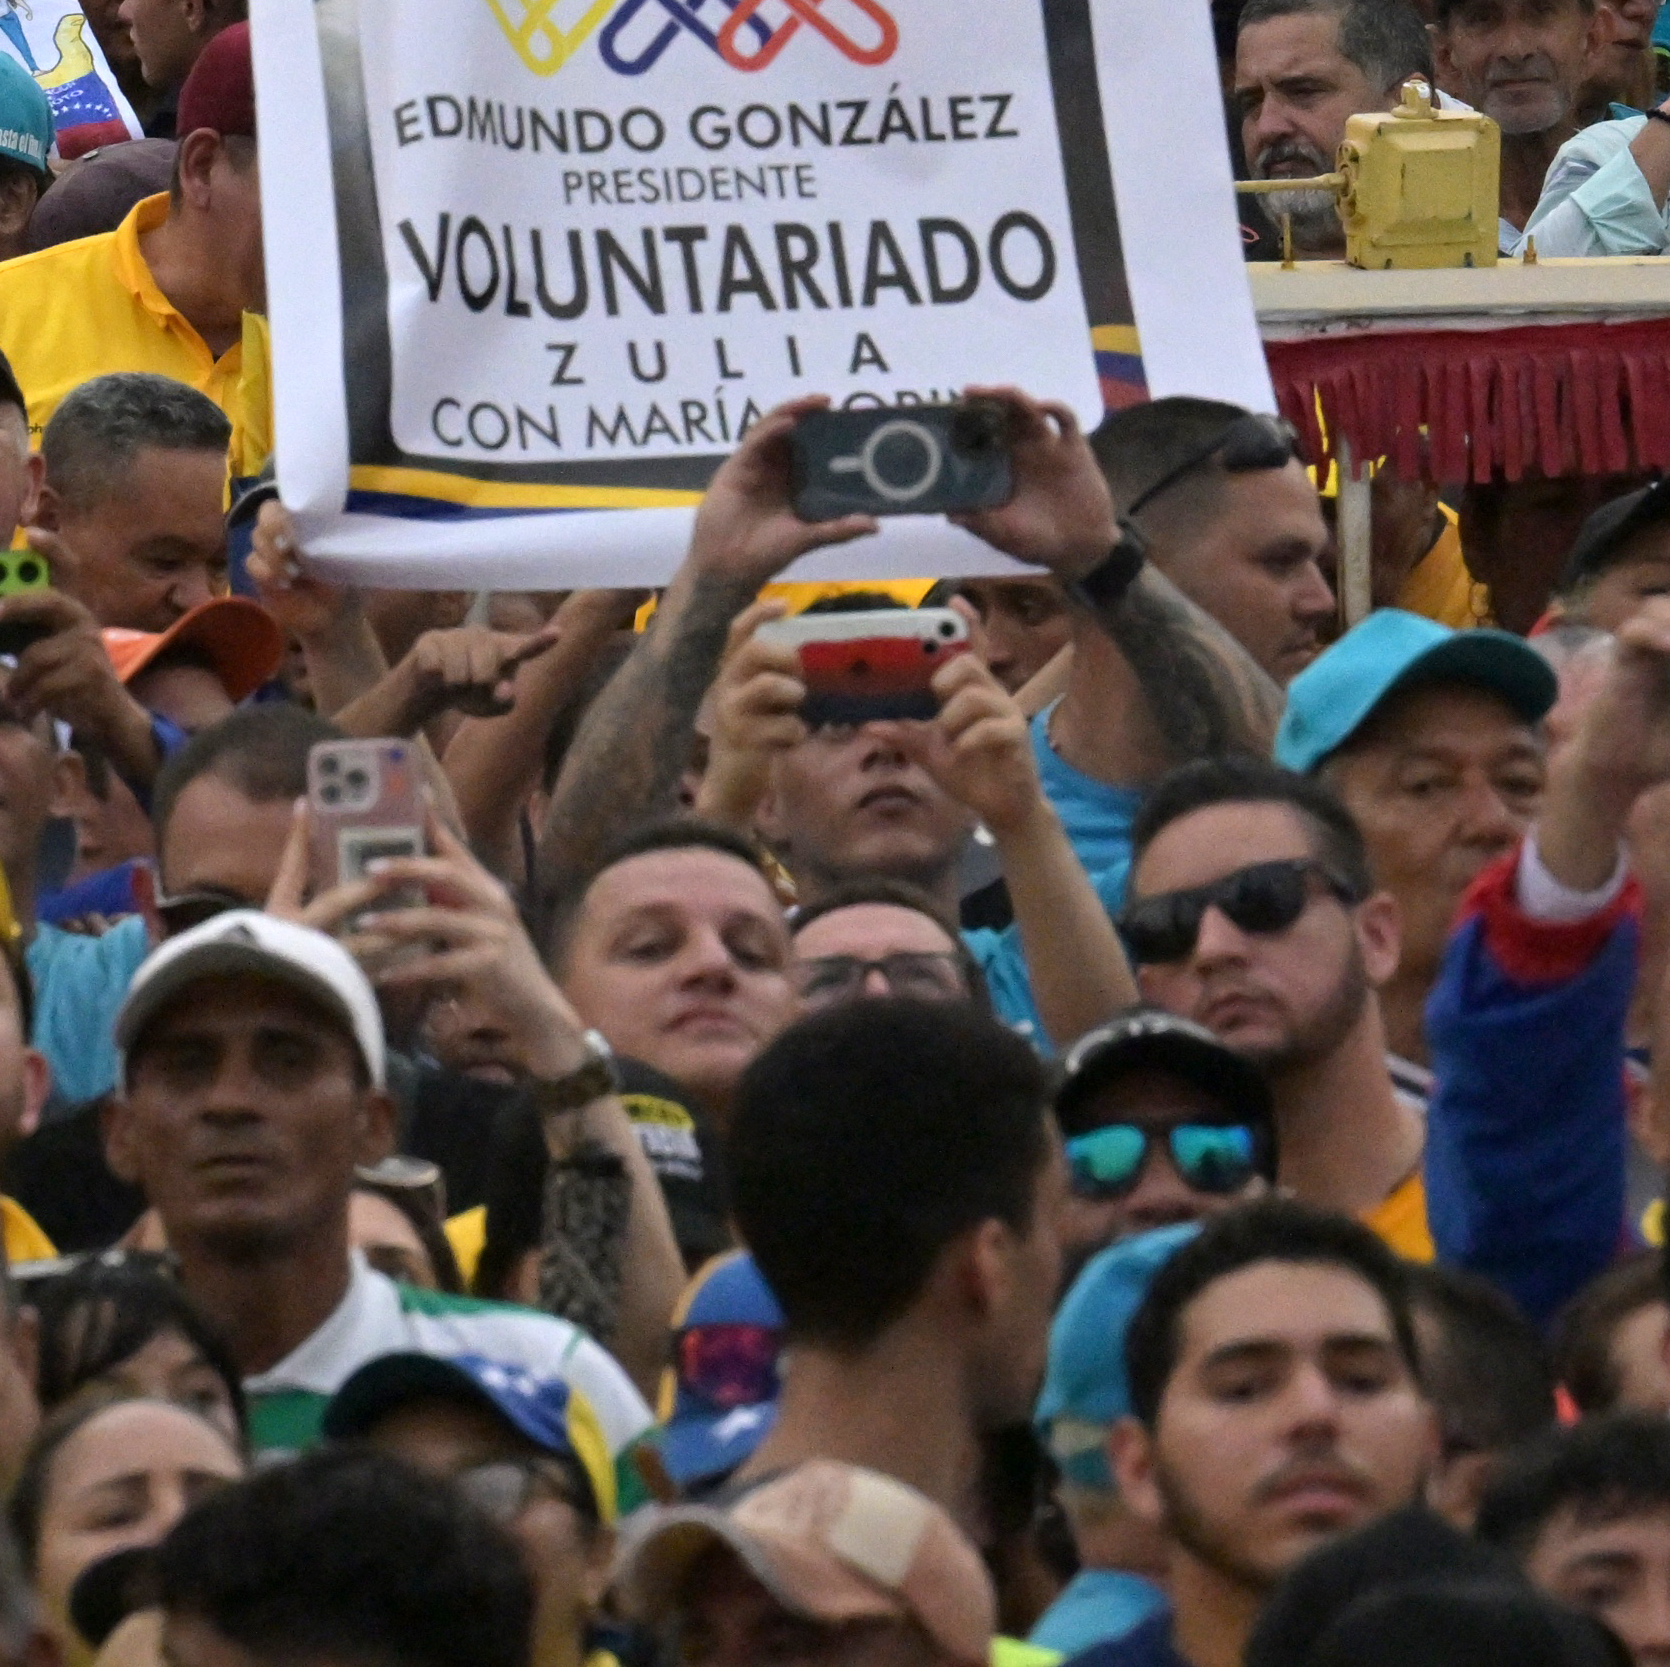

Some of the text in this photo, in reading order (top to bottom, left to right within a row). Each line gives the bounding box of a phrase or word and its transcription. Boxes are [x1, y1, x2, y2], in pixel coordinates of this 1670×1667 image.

[394, 83, 1019, 155] EDMUNDO GONZÁLEZ
[563, 163, 817, 205] PRESIDENTE
[398, 209, 1056, 320] VOLUNTARIADO
[431, 385, 762, 451] CON MARÍA
